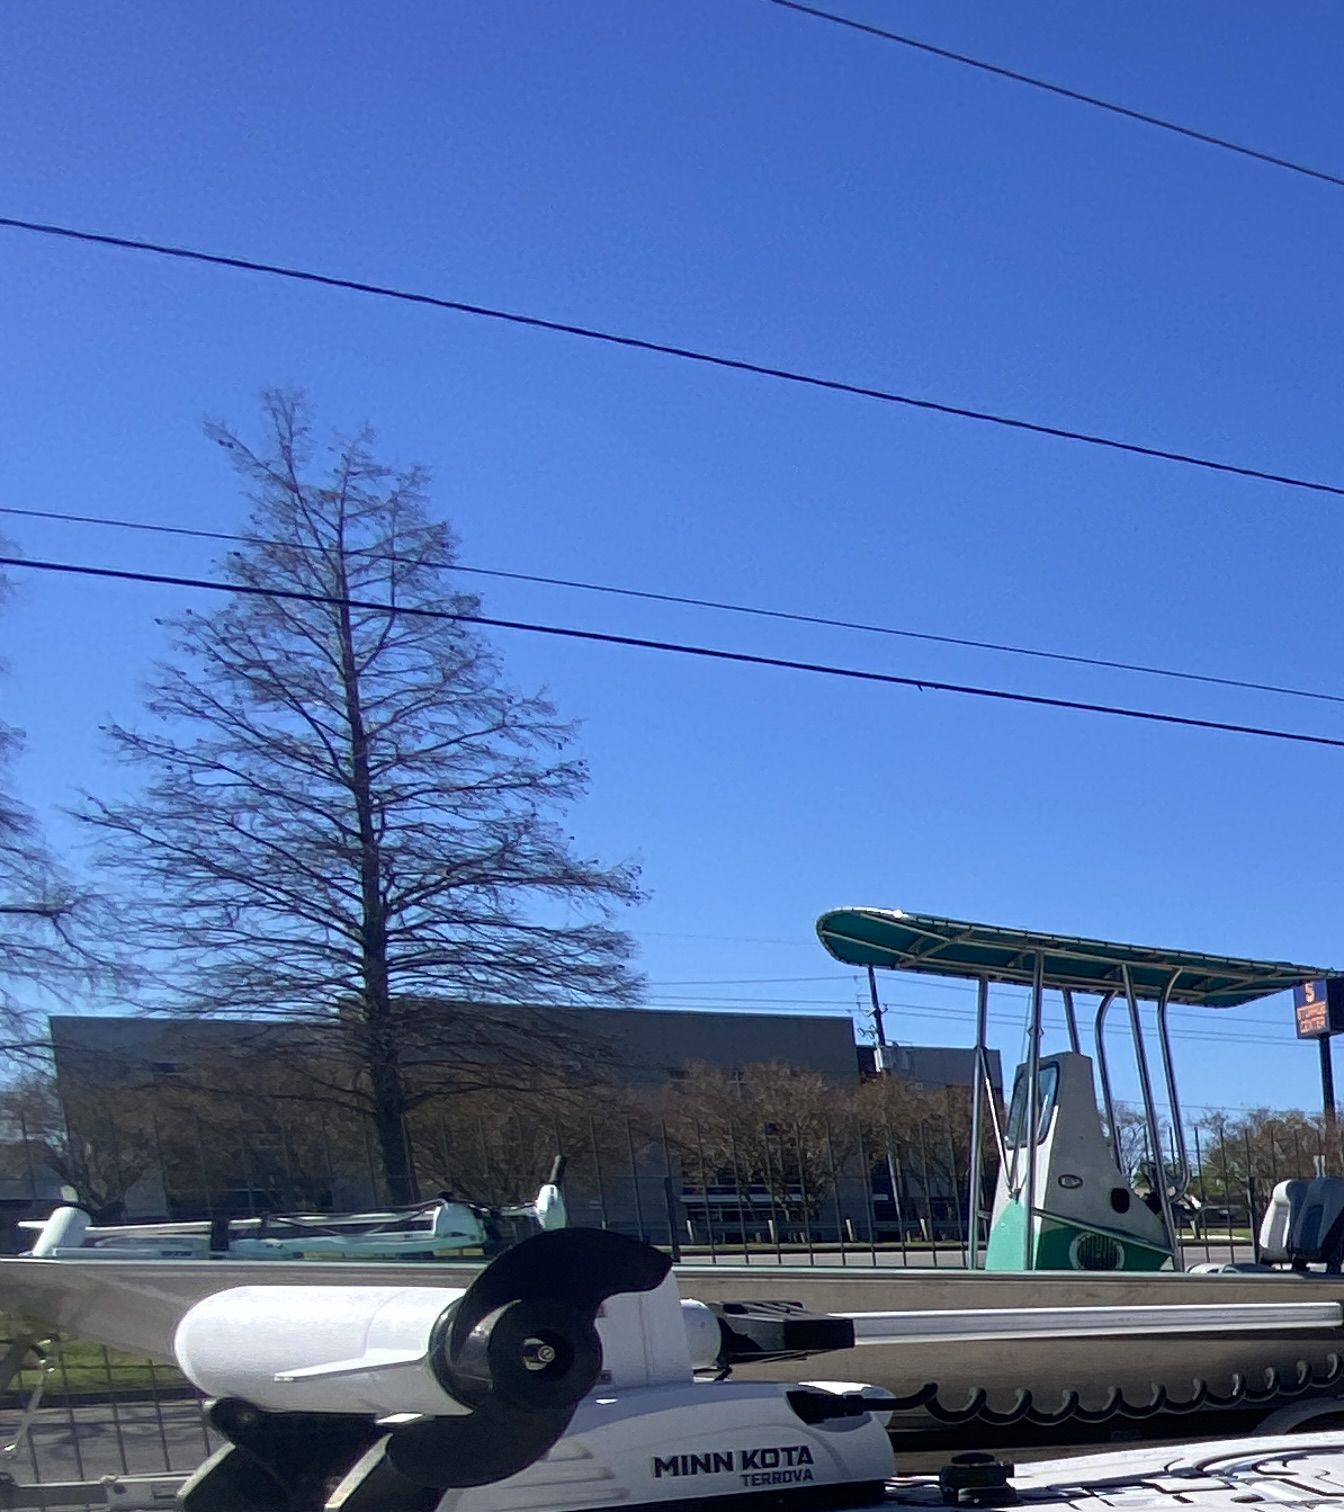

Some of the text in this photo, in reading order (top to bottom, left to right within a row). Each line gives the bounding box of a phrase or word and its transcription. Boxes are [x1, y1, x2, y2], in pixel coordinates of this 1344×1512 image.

[653, 1445, 815, 1479] MINN KOTA
[740, 1469, 815, 1488] TERROVA
